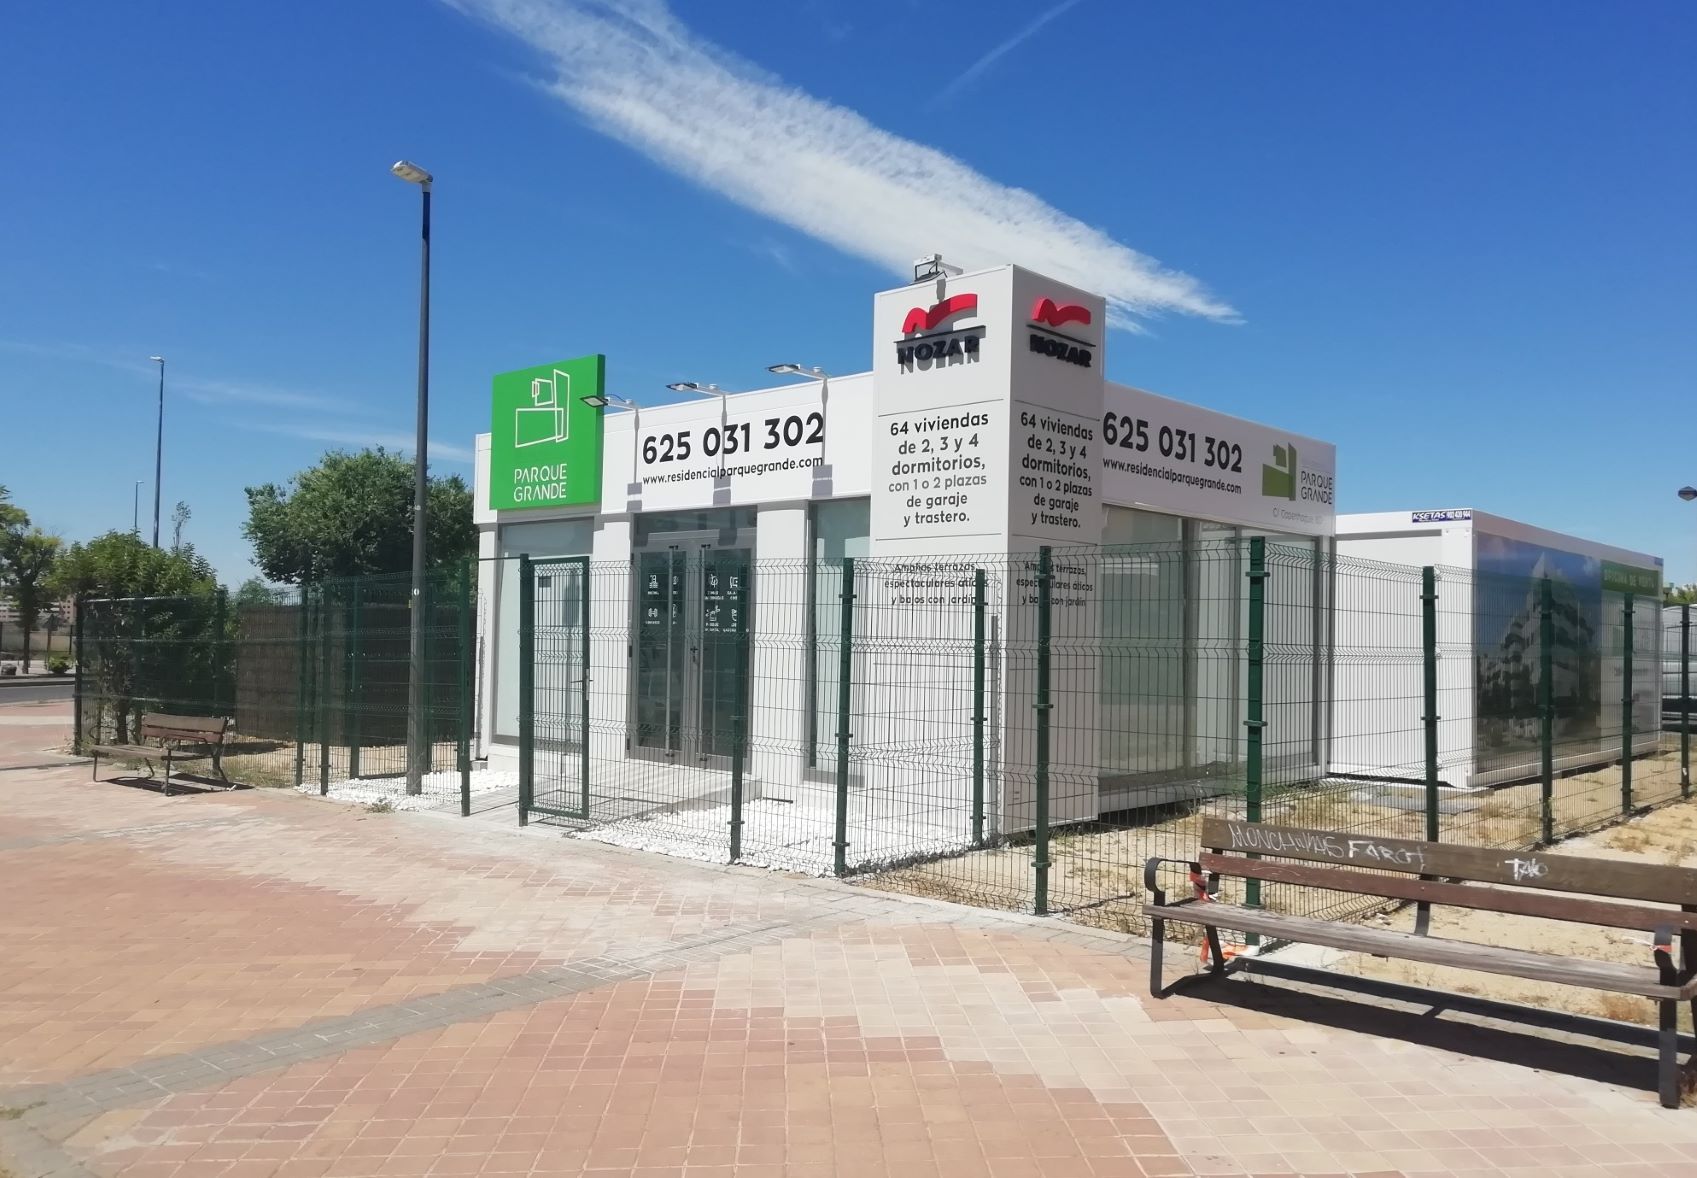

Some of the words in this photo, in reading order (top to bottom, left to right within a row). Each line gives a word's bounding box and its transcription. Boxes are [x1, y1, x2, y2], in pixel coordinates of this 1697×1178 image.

[897, 336, 980, 365] NOZAR
[1030, 334, 1092, 368] NOZAR
[890, 421, 909, 436] 64
[915, 412, 989, 433] viviendas
[1021, 412, 1036, 428] 64
[1040, 416, 1093, 441] viviendas
[643, 431, 691, 464] 625
[703, 422, 751, 457] 031
[764, 411, 824, 449] 302
[898, 440, 916, 455] de
[921, 439, 934, 454] 2,
[940, 436, 949, 451] 3
[954, 437, 963, 453] y
[969, 433, 979, 447] 4
[1027, 434, 1042, 450] de
[1046, 438, 1056, 455] 2,
[1060, 441, 1066, 455] 3
[1069, 445, 1076, 460] y
[1080, 446, 1087, 459] 4
[1103, 411, 1149, 452] 625
[1158, 425, 1195, 463] 031
[1204, 436, 1242, 473] 302
[514, 463, 567, 484] PARQUE
[643, 457, 823, 484] www.residencialparquegrande.com
[892, 454, 986, 476] dormitorios,
[1022, 453, 1091, 481] dormitorios,
[889, 481, 909, 492] con
[913, 479, 918, 490] 1
[922, 480, 929, 489] o
[933, 476, 941, 488] 2
[945, 474, 987, 490] plazas
[1019, 476, 1037, 488] con
[1040, 477, 1044, 488] 1
[1046, 481, 1052, 490] o
[1055, 480, 1061, 491] 2
[1063, 481, 1092, 496] plazas
[1102, 458, 1242, 494] www.residencialparquegrande.com
[1301, 470, 1333, 491] PARQUE
[513, 482, 567, 502] GRANDE
[906, 495, 922, 507] de
[926, 491, 968, 509] garaje
[1301, 486, 1333, 505] GRANDE
[1033, 493, 1046, 506] de
[1049, 498, 1079, 513] garaje
[903, 516, 911, 527] y
[915, 510, 970, 524] trastero.
[1031, 512, 1038, 525] y
[1040, 511, 1081, 528] trastero.
[891, 596, 897, 606] y
[928, 596, 945, 604] con
[1022, 595, 1027, 606] y
